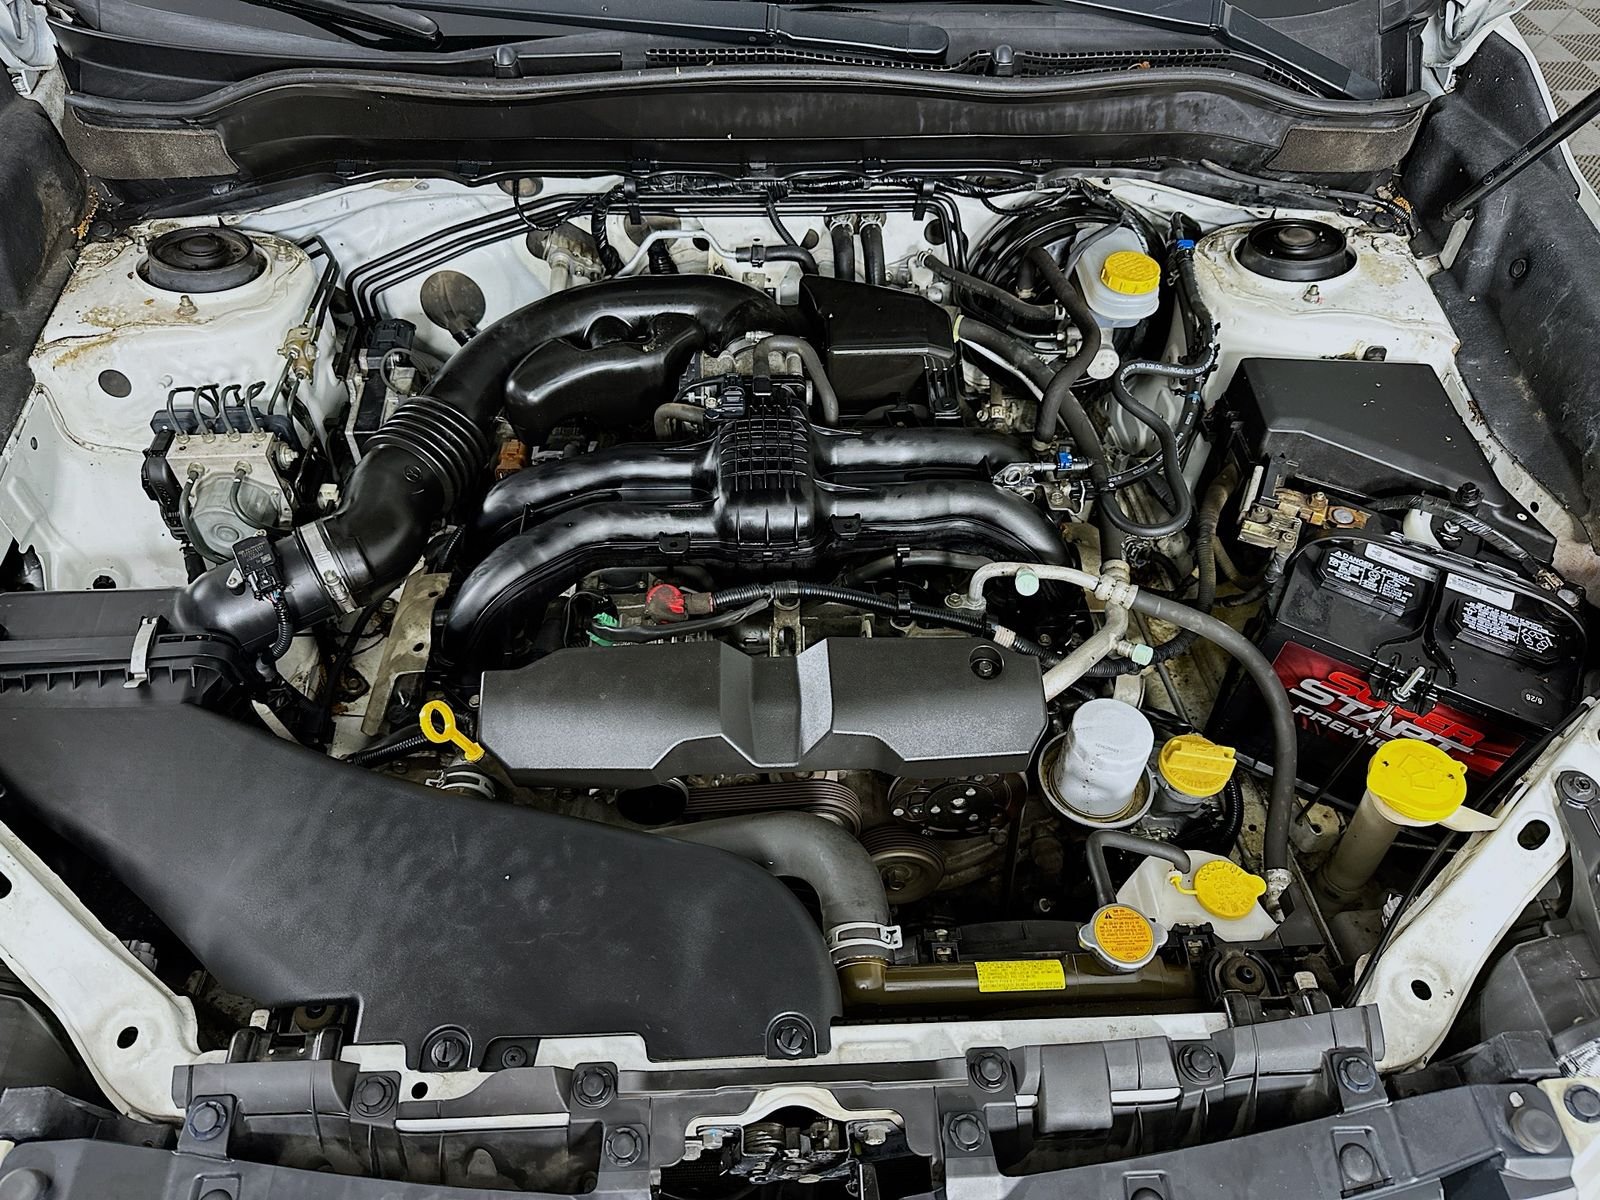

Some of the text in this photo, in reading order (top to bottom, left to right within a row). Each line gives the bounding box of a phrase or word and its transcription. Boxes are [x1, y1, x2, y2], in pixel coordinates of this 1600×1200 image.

[1343, 553, 1375, 569] DANGER
[1380, 567, 1410, 583] POISON
[1292, 704, 1387, 748] PREMI
[1319, 671, 1485, 747] SUER
